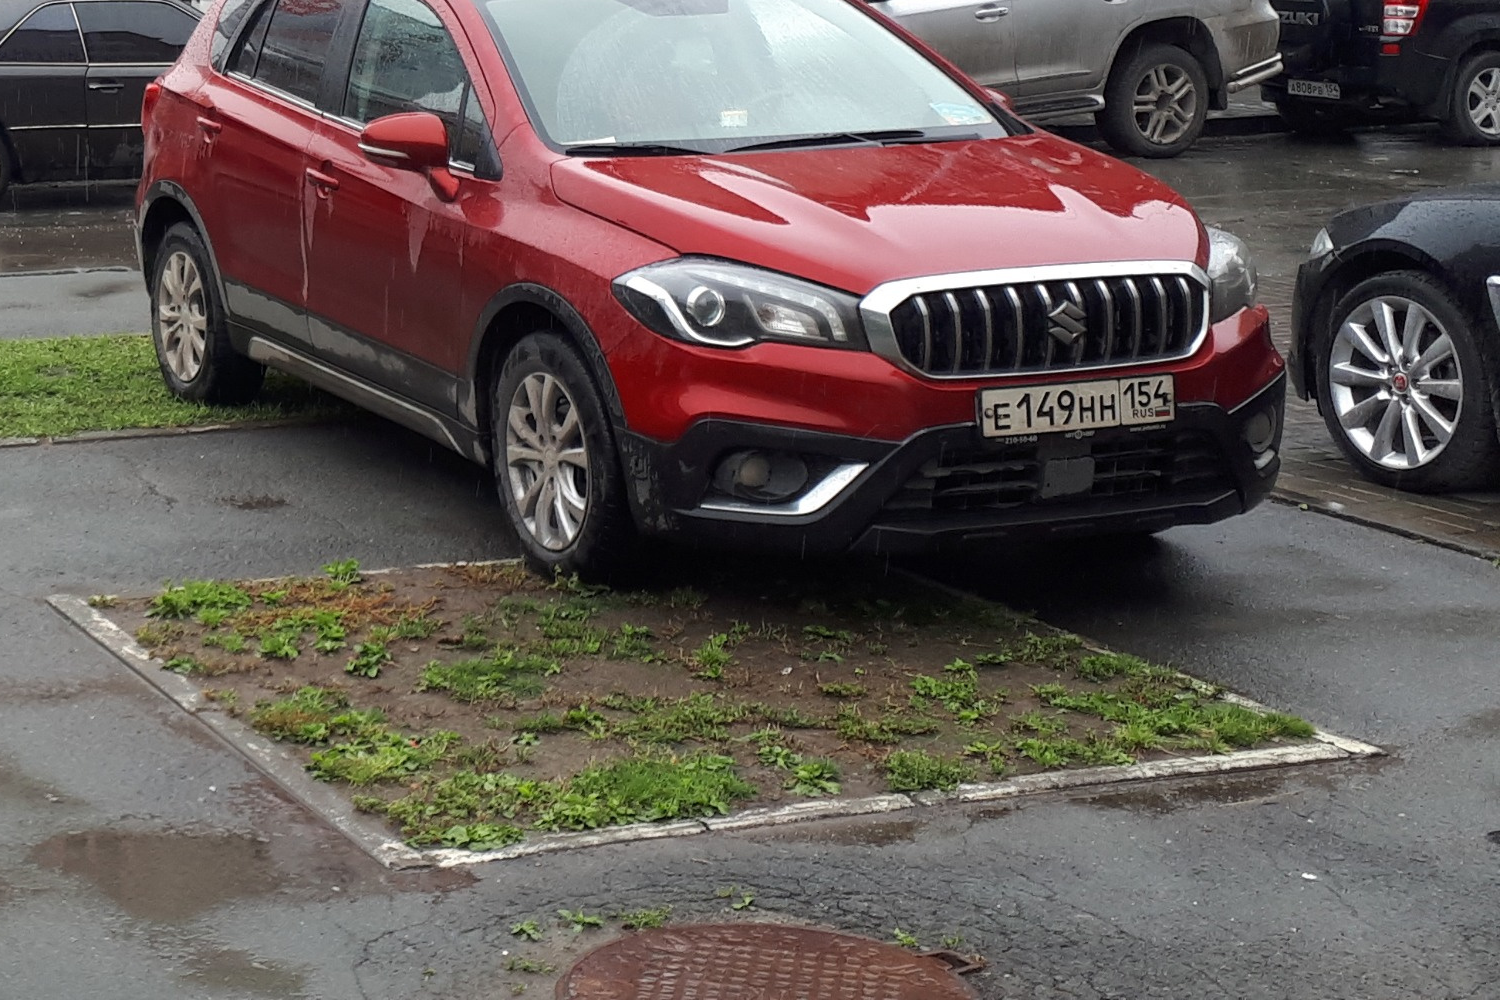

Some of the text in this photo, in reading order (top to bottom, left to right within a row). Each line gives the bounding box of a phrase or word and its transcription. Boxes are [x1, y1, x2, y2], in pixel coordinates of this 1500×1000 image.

[1277, 10, 1319, 26] ZUKI
[1325, 83, 1339, 94] 154
[993, 380, 1168, 431] Е149НН 154
[1132, 408, 1154, 419] RUS
